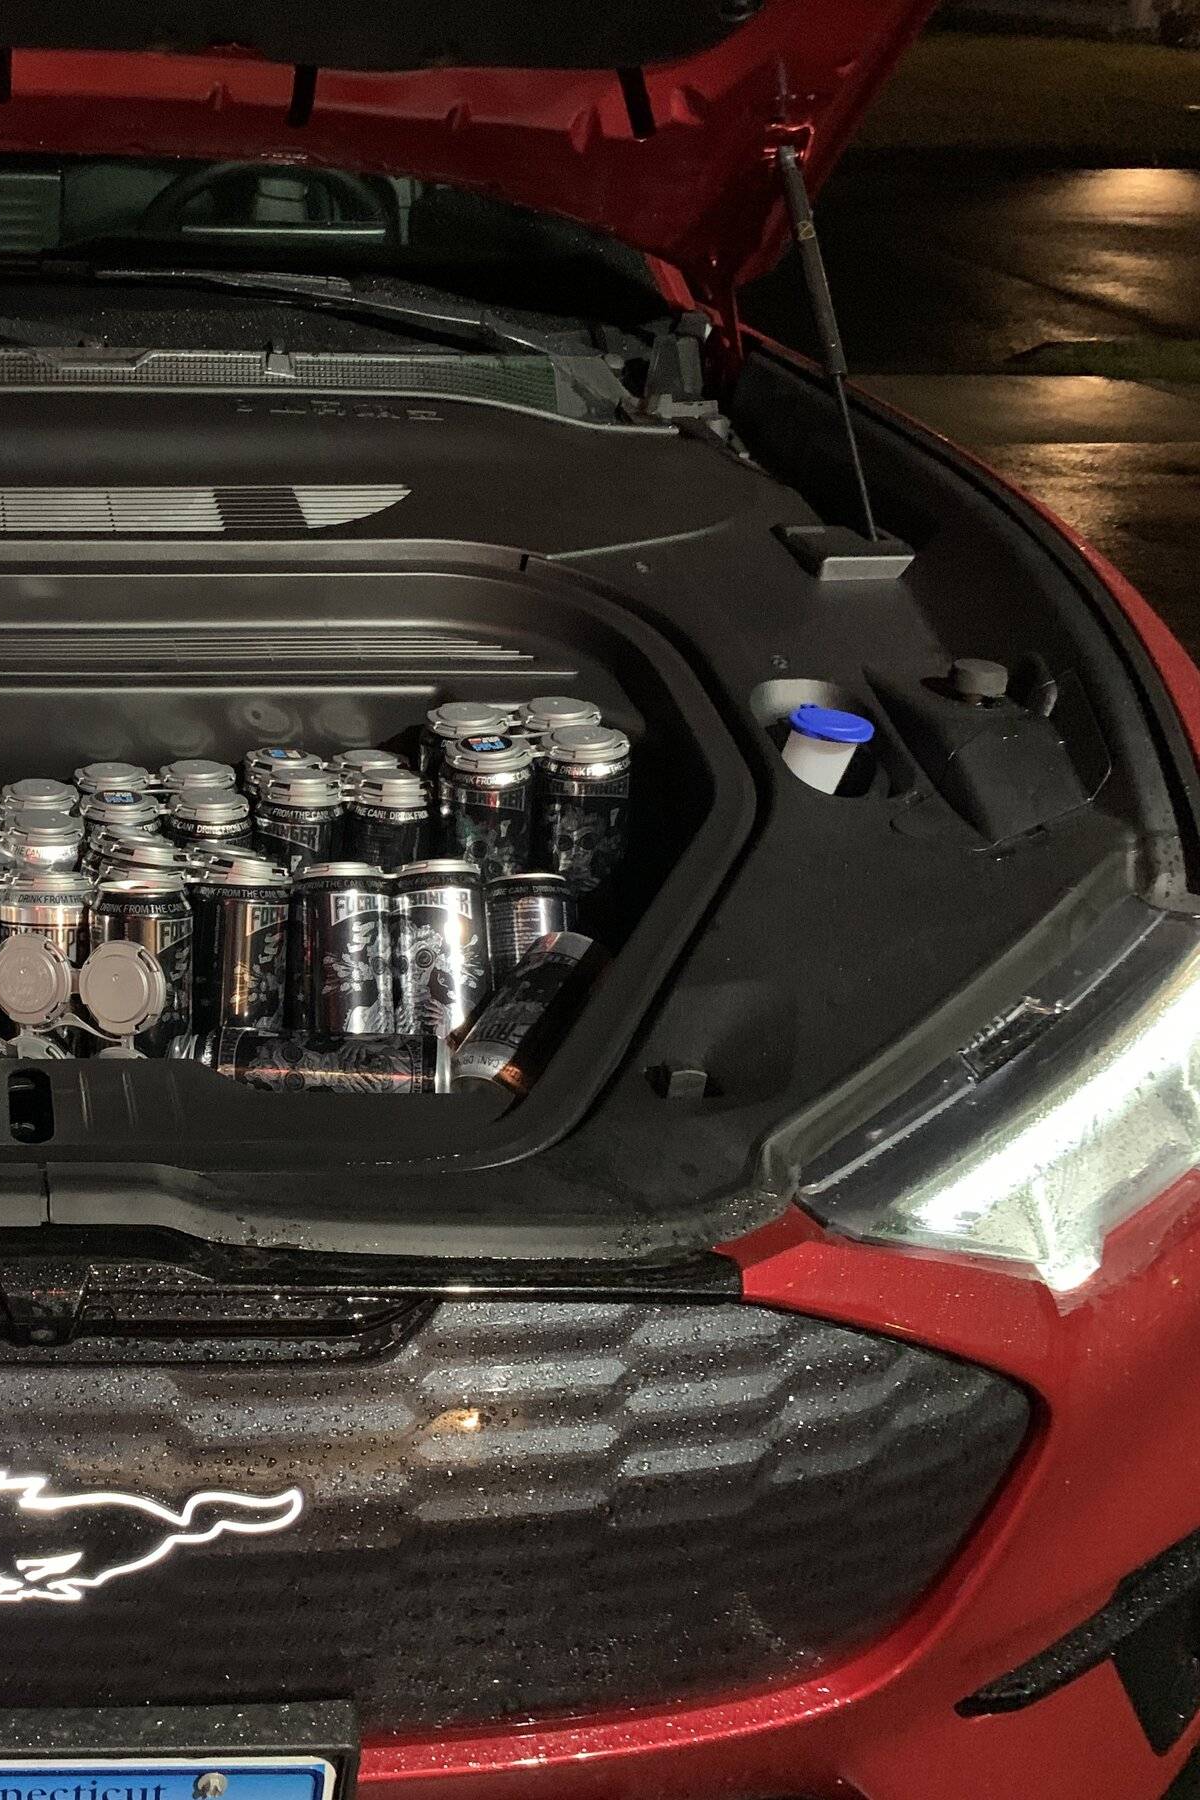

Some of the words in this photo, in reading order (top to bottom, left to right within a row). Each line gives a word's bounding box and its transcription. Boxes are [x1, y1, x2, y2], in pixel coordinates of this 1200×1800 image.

[18, 894, 42, 904] DRINK
[43, 894, 69, 904] FROM
[241, 889, 259, 899] THE
[123, 903, 148, 914] FROM
[150, 903, 167, 914] THE
